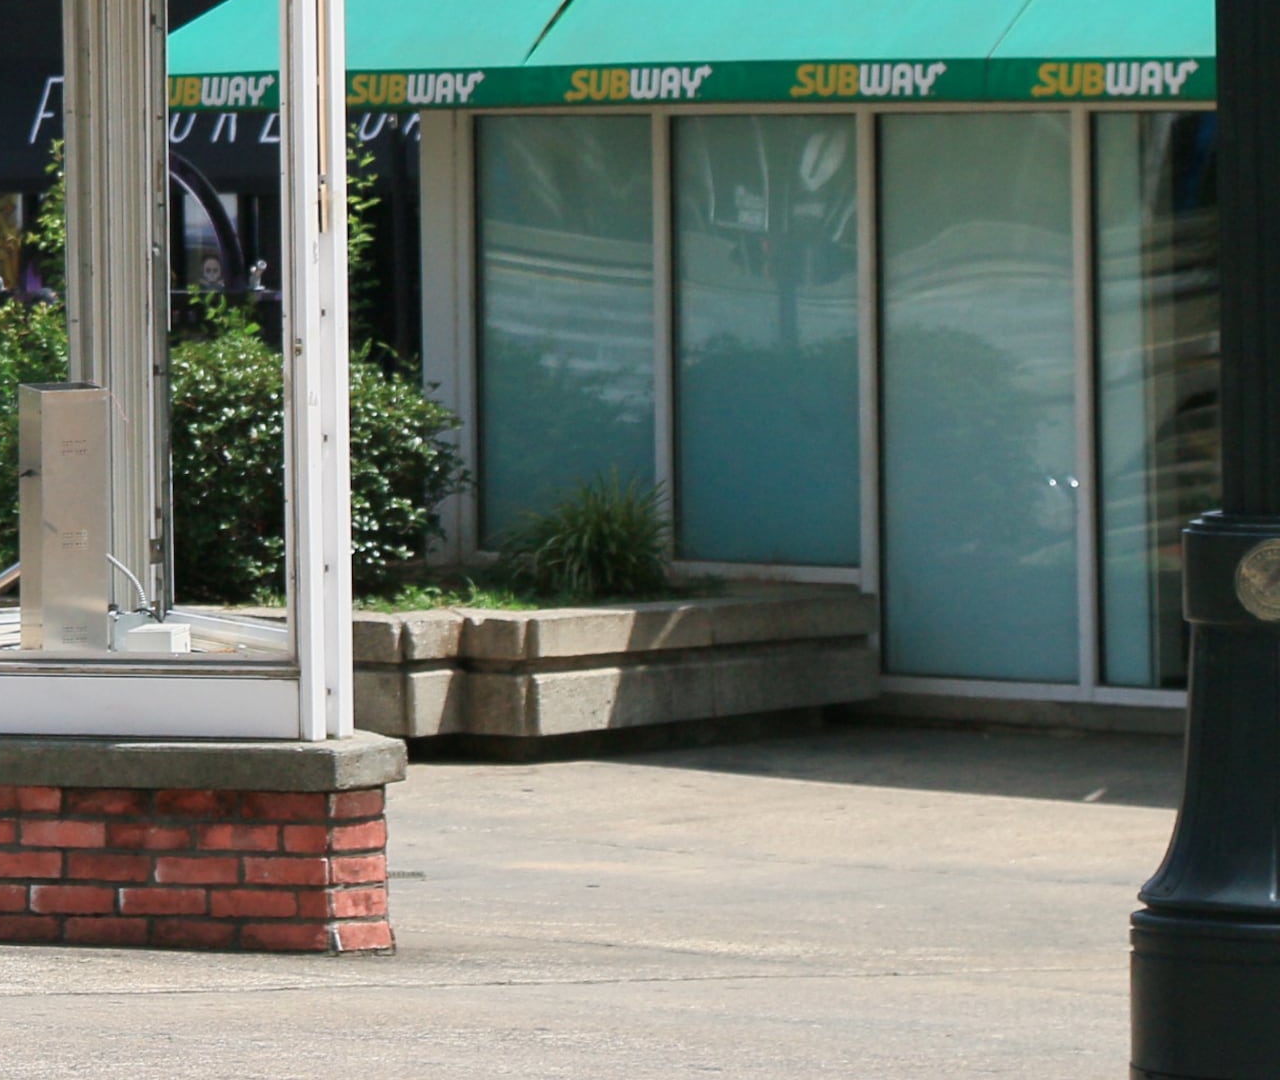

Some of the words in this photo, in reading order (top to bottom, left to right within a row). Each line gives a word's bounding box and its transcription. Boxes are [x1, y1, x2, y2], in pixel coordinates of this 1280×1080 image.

[168, 75, 275, 107] UBWAY
[347, 72, 485, 104] SUBWAY
[564, 64, 713, 102] SUBWAY
[790, 62, 947, 97] SUBWAY
[1031, 59, 1199, 97] SUBWAY
